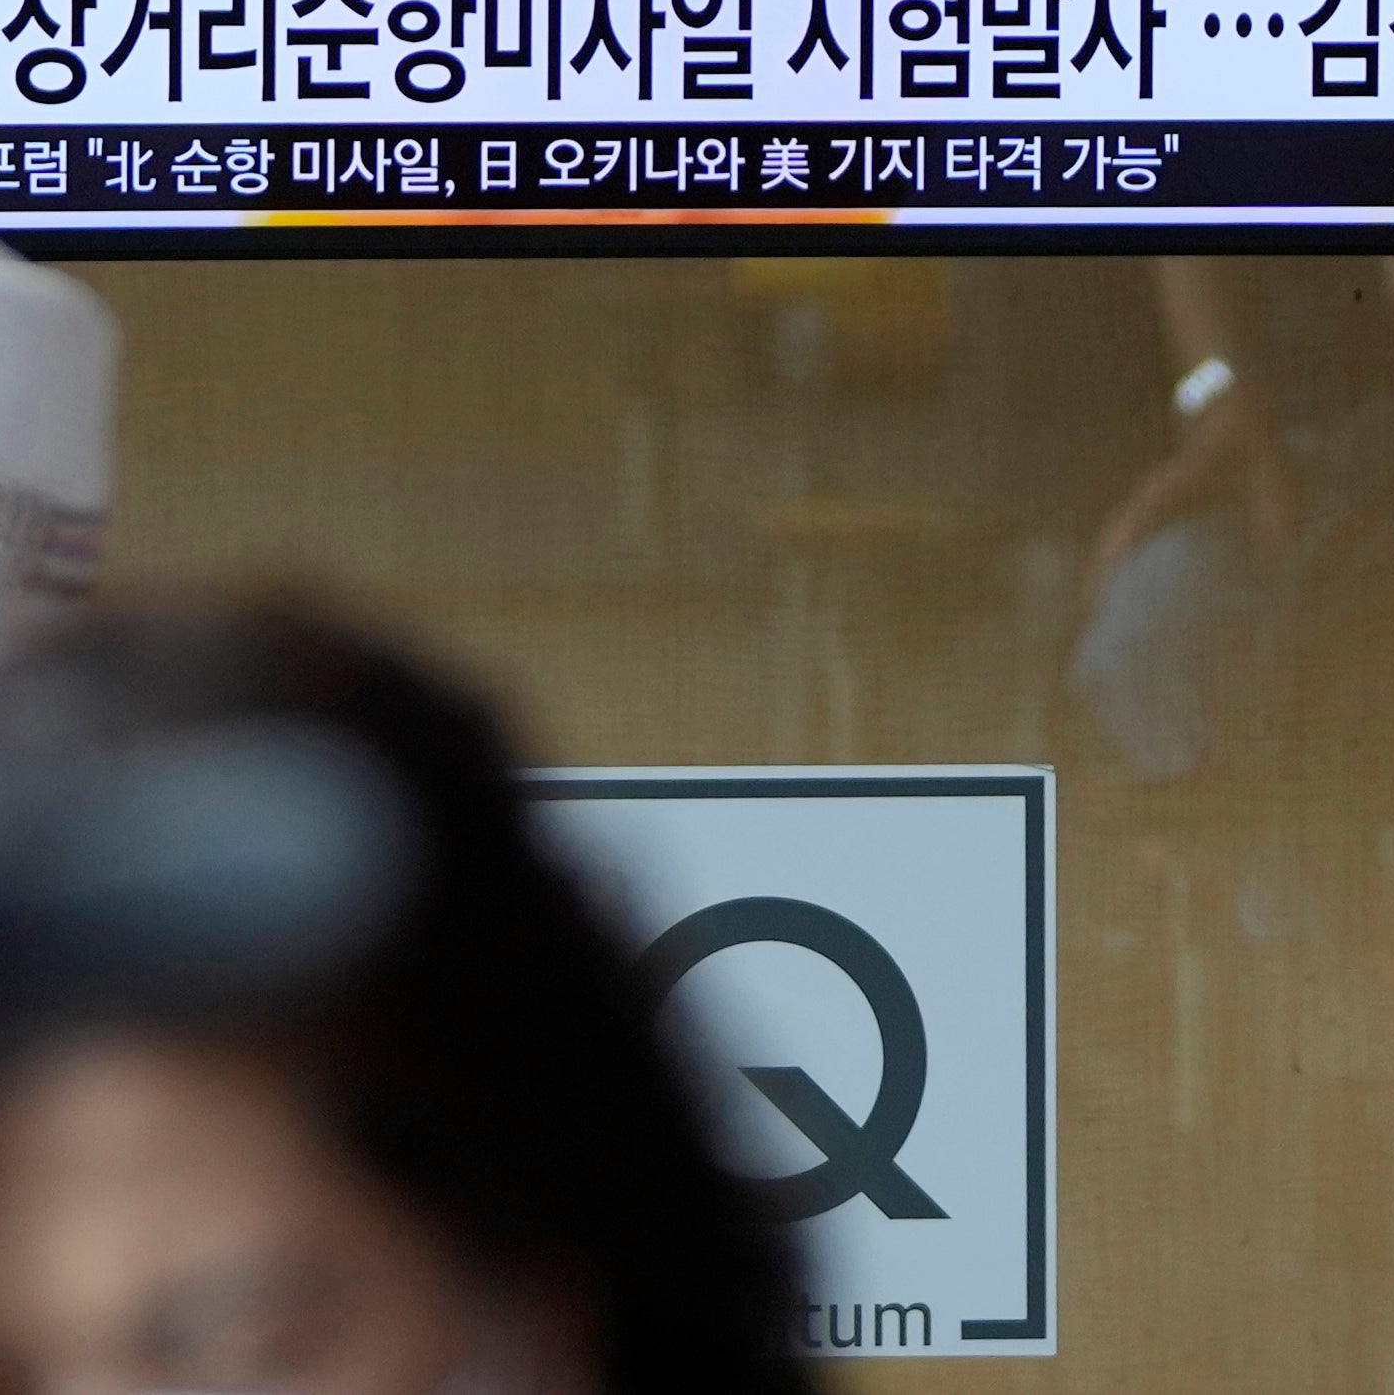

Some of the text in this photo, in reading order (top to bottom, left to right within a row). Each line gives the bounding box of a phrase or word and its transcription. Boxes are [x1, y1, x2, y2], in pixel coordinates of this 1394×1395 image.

[89, 138, 156, 192] "北
[172, 139, 274, 193] 순항
[293, 139, 454, 196] 미사일,
[481, 141, 516, 190] 日
[540, 137, 745, 191] 오키나와
[761, 138, 809, 189] 美
[829, 137, 924, 190] 기지
[947, 136, 1041, 190] 타격
[1063, 134, 1178, 190] 가능"
